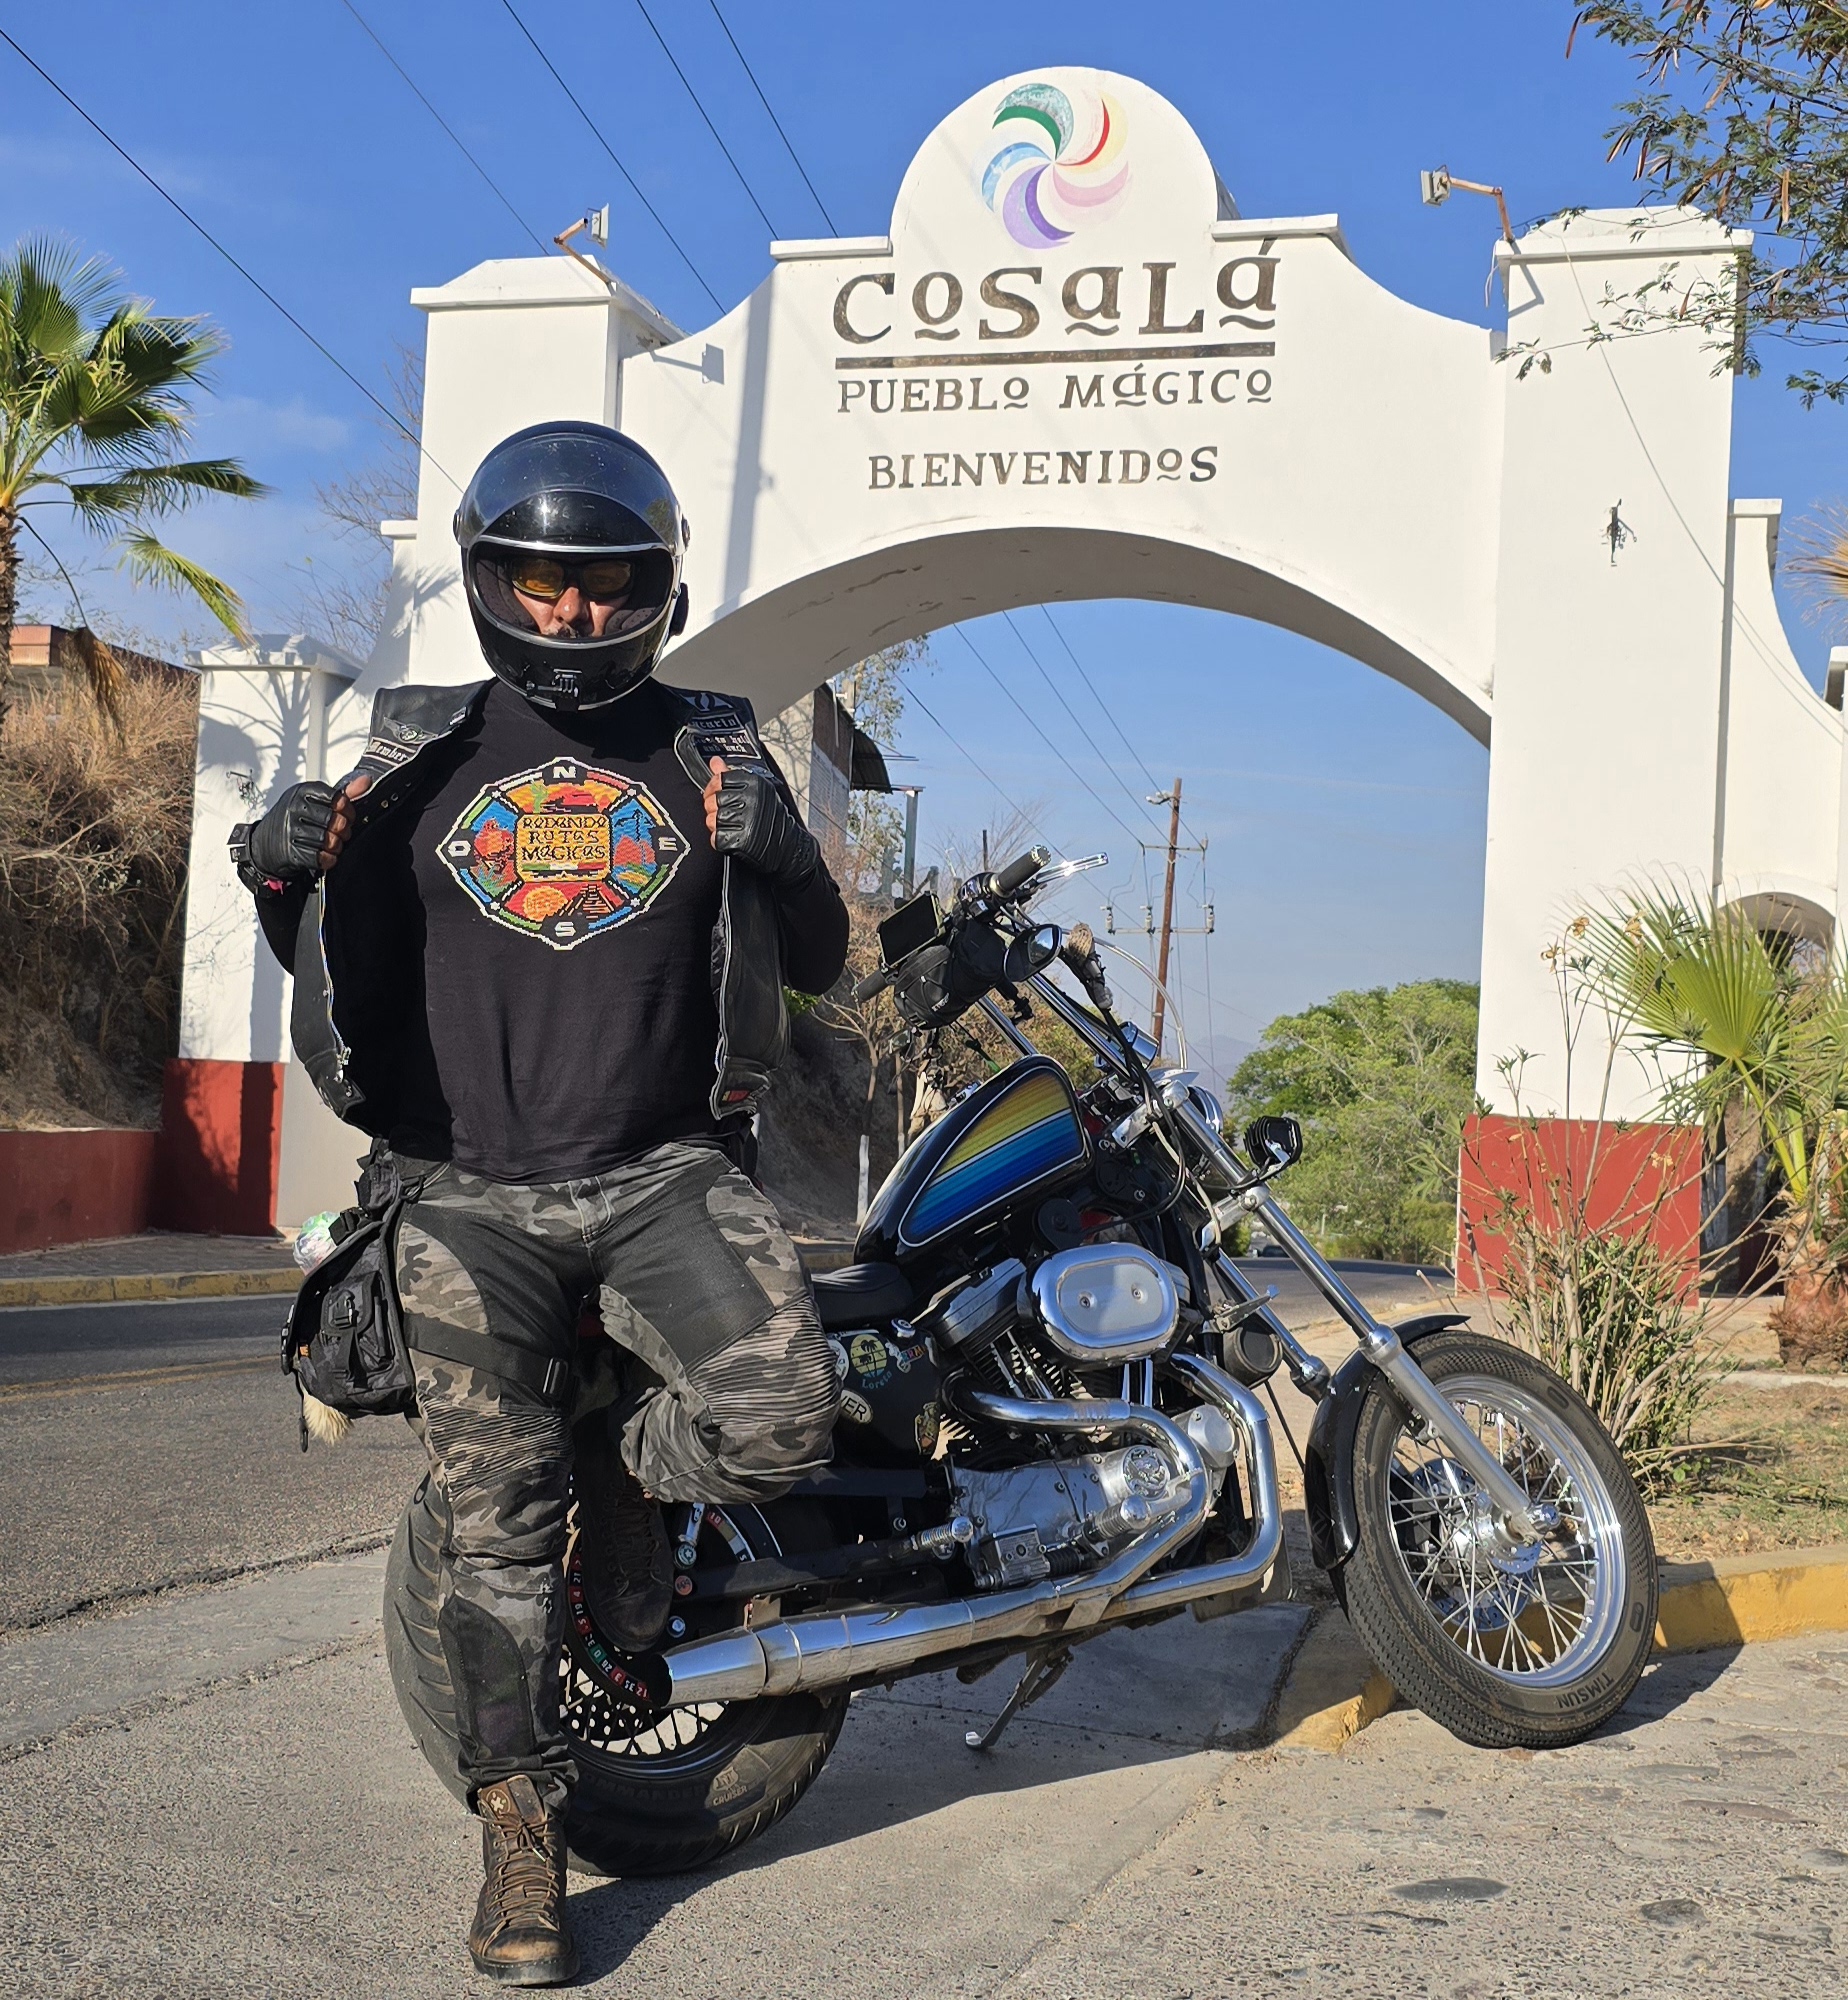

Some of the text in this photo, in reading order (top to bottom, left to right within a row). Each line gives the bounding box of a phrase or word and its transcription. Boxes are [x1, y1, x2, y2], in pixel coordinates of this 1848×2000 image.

[837, 377, 1030, 413] PUEBLO
[868, 446, 1218, 490] BIENVENIDOS
[553, 766, 577, 779] N
[448, 840, 472, 857] O
[659, 837, 678, 851] E
[554, 921, 576, 937] S
[843, 1395, 867, 1420] ER
[1555, 1672, 1614, 1708] TIMSUN
[712, 1785, 747, 1806] CRUISER
